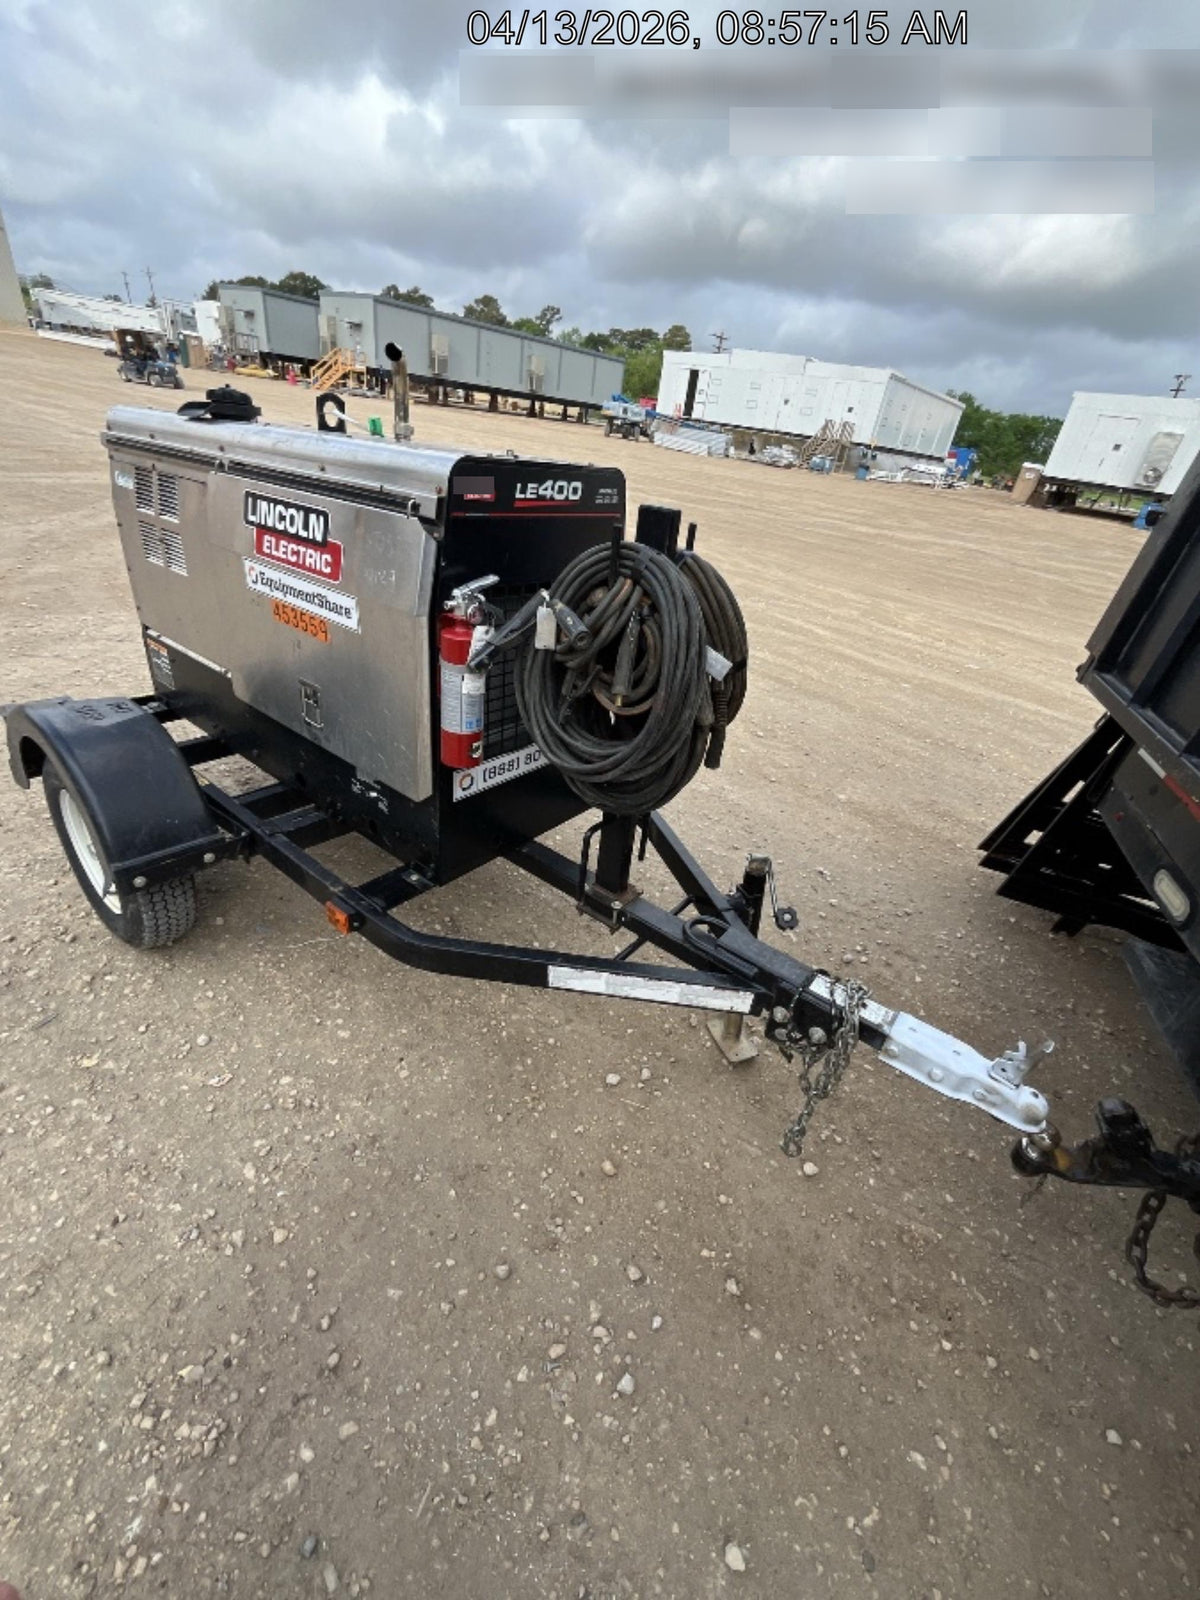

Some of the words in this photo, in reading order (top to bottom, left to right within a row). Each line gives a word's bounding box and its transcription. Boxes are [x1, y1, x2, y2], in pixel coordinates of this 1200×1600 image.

[515, 480, 582, 501] LE400
[247, 497, 324, 541] LINCOLN
[263, 535, 332, 574] ELECTRIC
[258, 572, 352, 619] EquipmentShare
[273, 602, 328, 642] 453559
